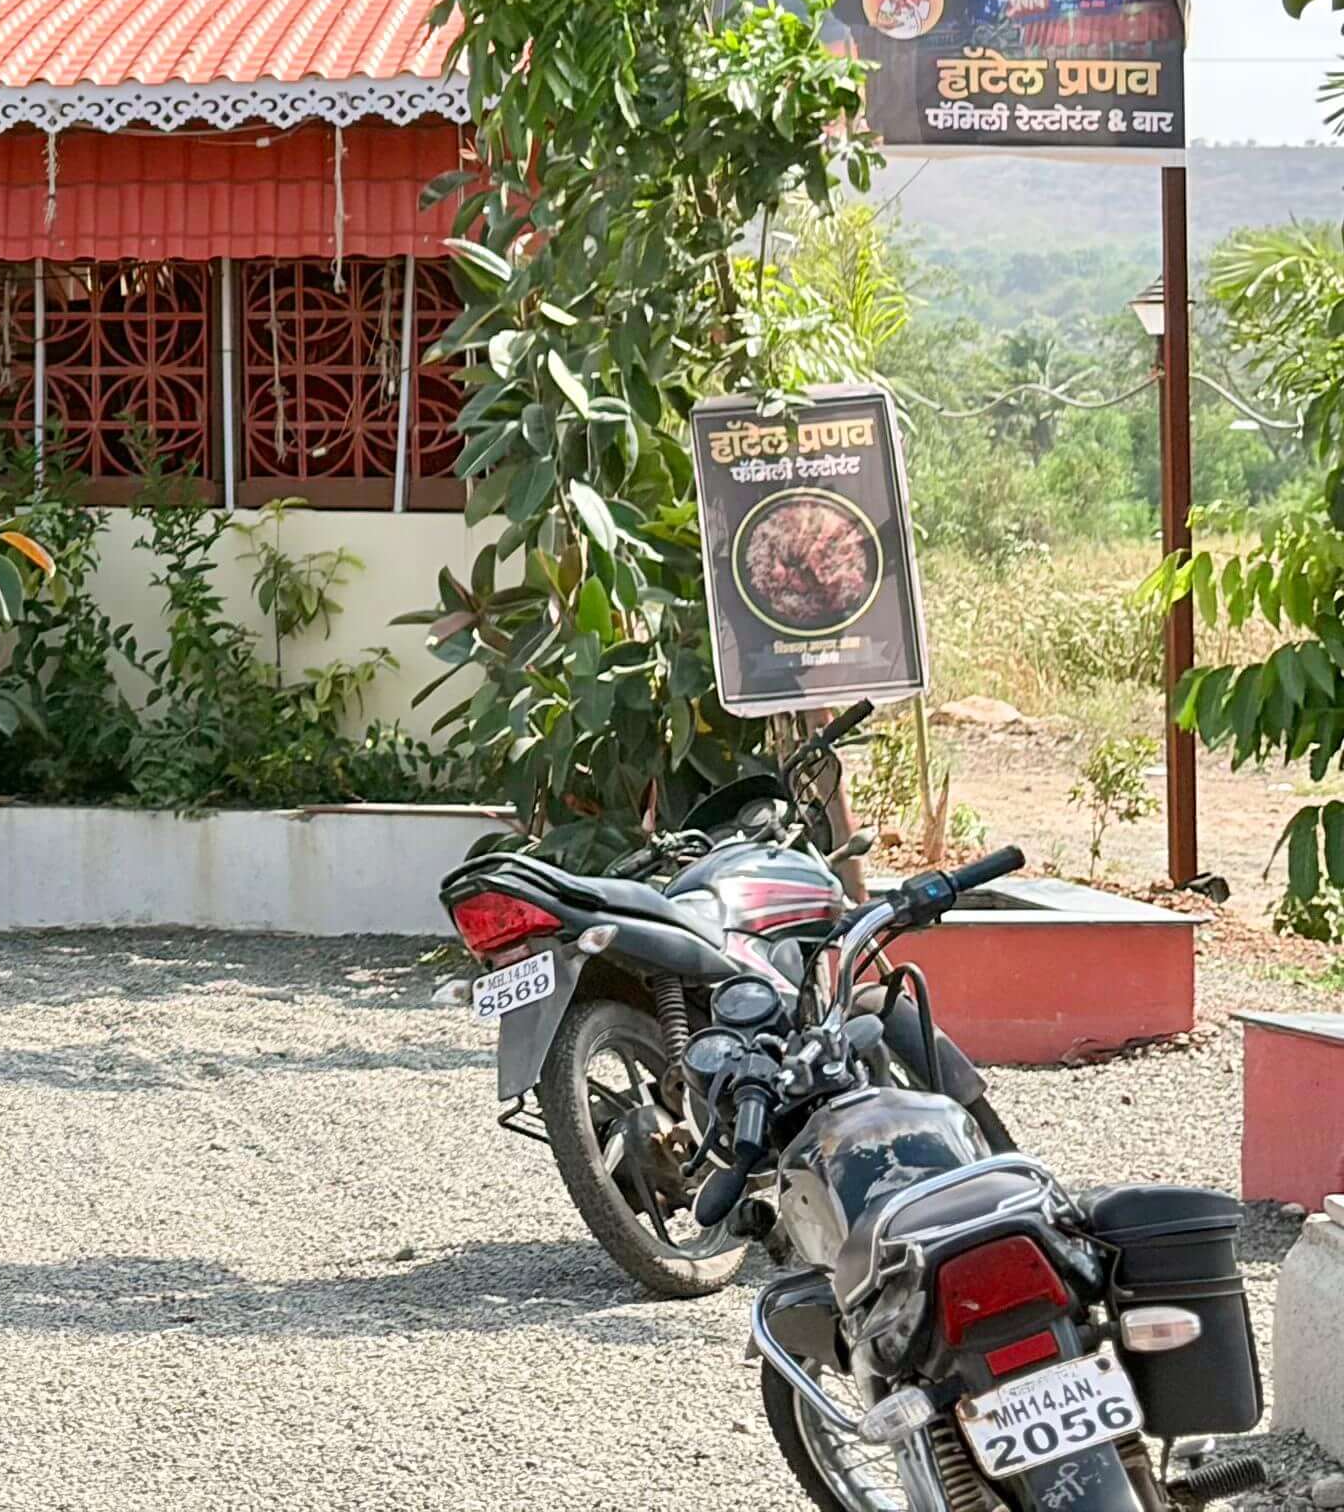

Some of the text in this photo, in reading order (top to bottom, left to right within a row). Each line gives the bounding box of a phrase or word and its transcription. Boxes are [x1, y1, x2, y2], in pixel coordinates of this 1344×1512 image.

[936, 46, 1161, 100] हॉटेल प्रणव
[1015, 104, 1103, 133] रेस्टोरंट
[1107, 111, 1127, 133] &
[1132, 109, 1175, 134] बार
[709, 418, 875, 463] हॉटेल प्रणव
[478, 973, 550, 1017] 8569
[985, 1396, 1133, 1472] 2056
